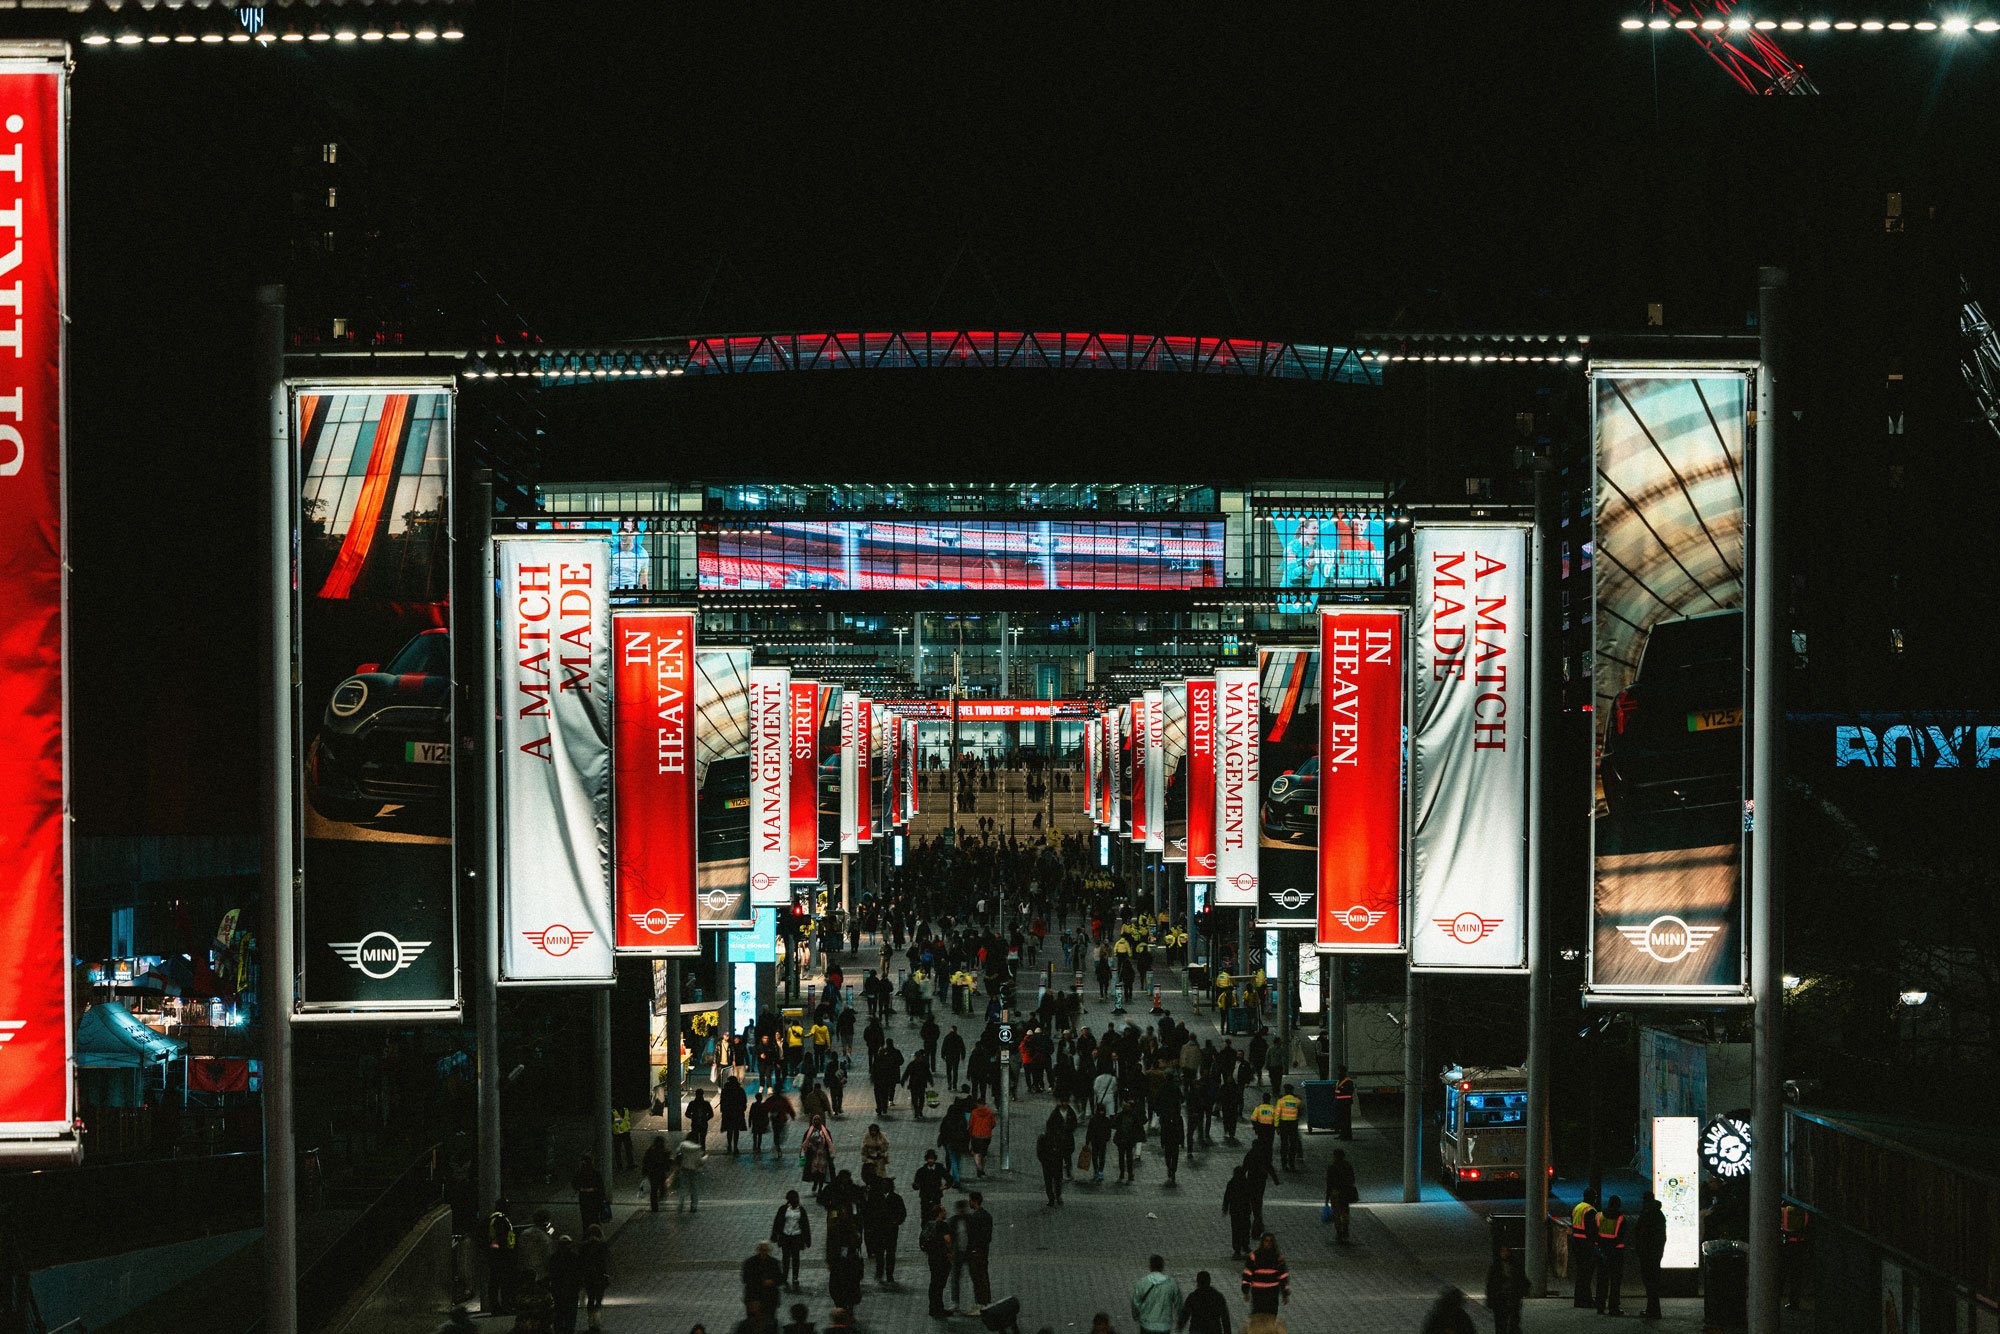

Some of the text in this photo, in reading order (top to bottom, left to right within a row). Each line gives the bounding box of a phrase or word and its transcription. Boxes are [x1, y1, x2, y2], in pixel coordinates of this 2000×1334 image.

[560, 563, 592, 693] MADE
[1433, 551, 1466, 681] MADE
[518, 563, 551, 764] A MATCH
[625, 630, 651, 666] IN
[1365, 628, 1391, 666] IN
[1474, 551, 1507, 752] A MATCH
[657, 630, 684, 774] HEAVEN.
[957, 705, 974, 716] EVEL
[974, 705, 992, 716] TWO
[993, 705, 1014, 716] WEST
[1020, 706, 1034, 716] use
[1193, 689, 1210, 757] SPIRIT.
[1332, 628, 1360, 773] HEAVEN.
[795, 690, 812, 759] SPIRIT.
[842, 701, 853, 748] MADE
[1150, 701, 1163, 748] MADE
[763, 682, 781, 852] MANAGEMENT.
[1225, 682, 1243, 852] MANAGEMENT.
[546, 936, 570, 945] MINI
[647, 917, 667, 925] MINI
[1456, 924, 1480, 932] MINI
[1651, 933, 1685, 945] MINI
[363, 949, 397, 961] MINI
[1717, 1152, 1751, 1177] COFFE
